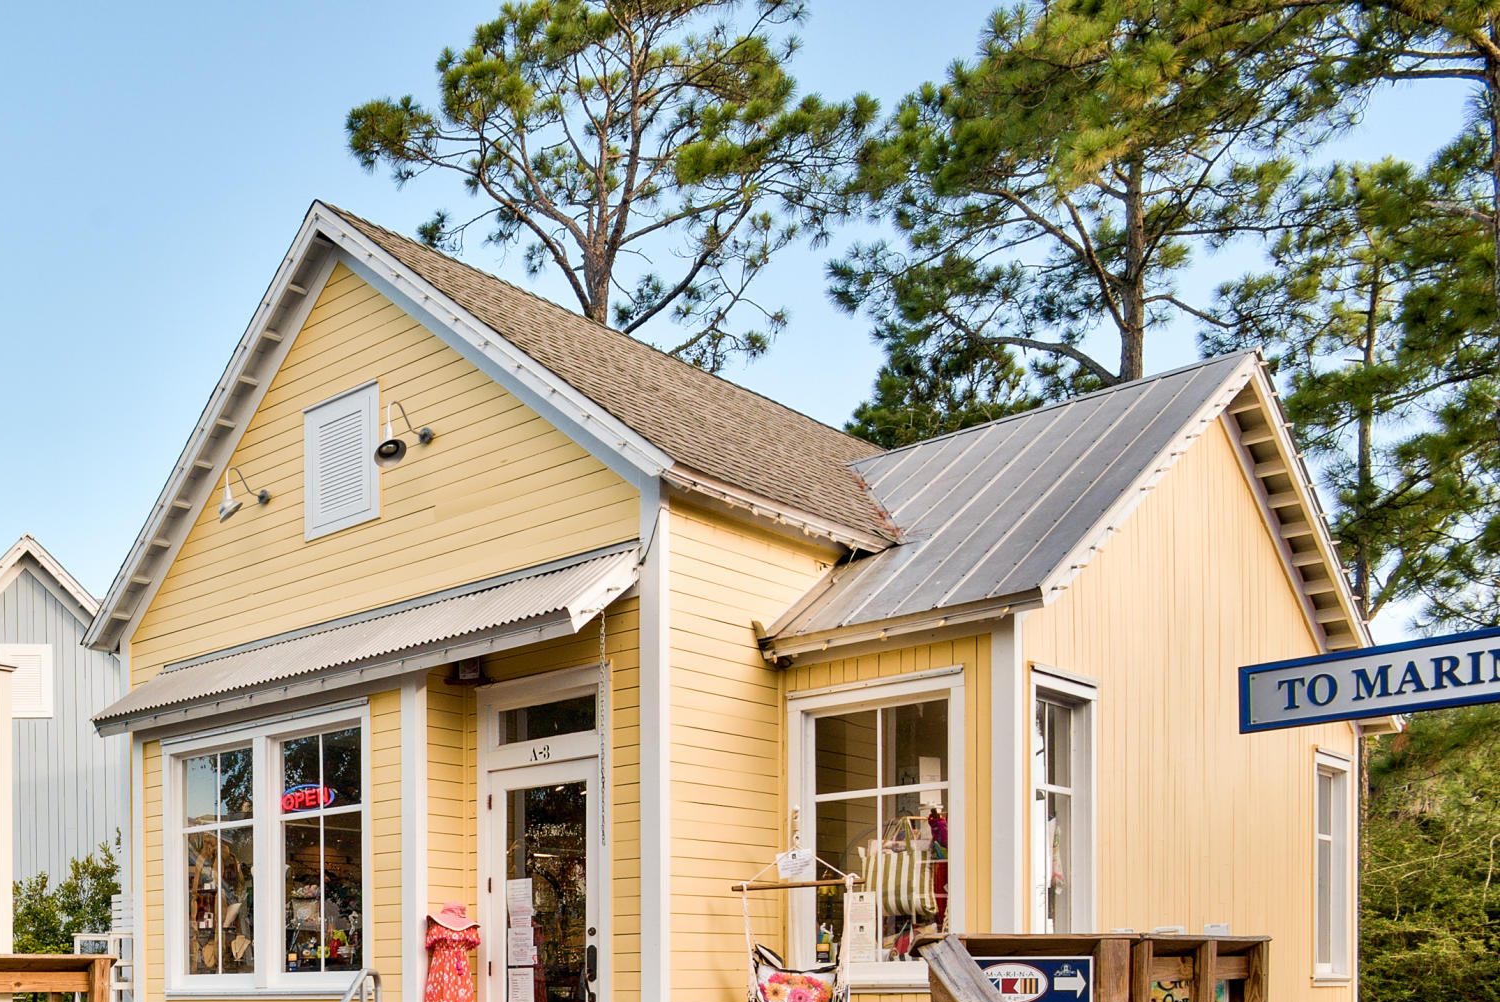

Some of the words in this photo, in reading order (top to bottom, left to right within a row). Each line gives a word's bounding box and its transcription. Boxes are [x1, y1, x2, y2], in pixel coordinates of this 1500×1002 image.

[1277, 674, 1338, 710] TO
[529, 744, 550, 762] A-3
[282, 786, 329, 810] OPEN
